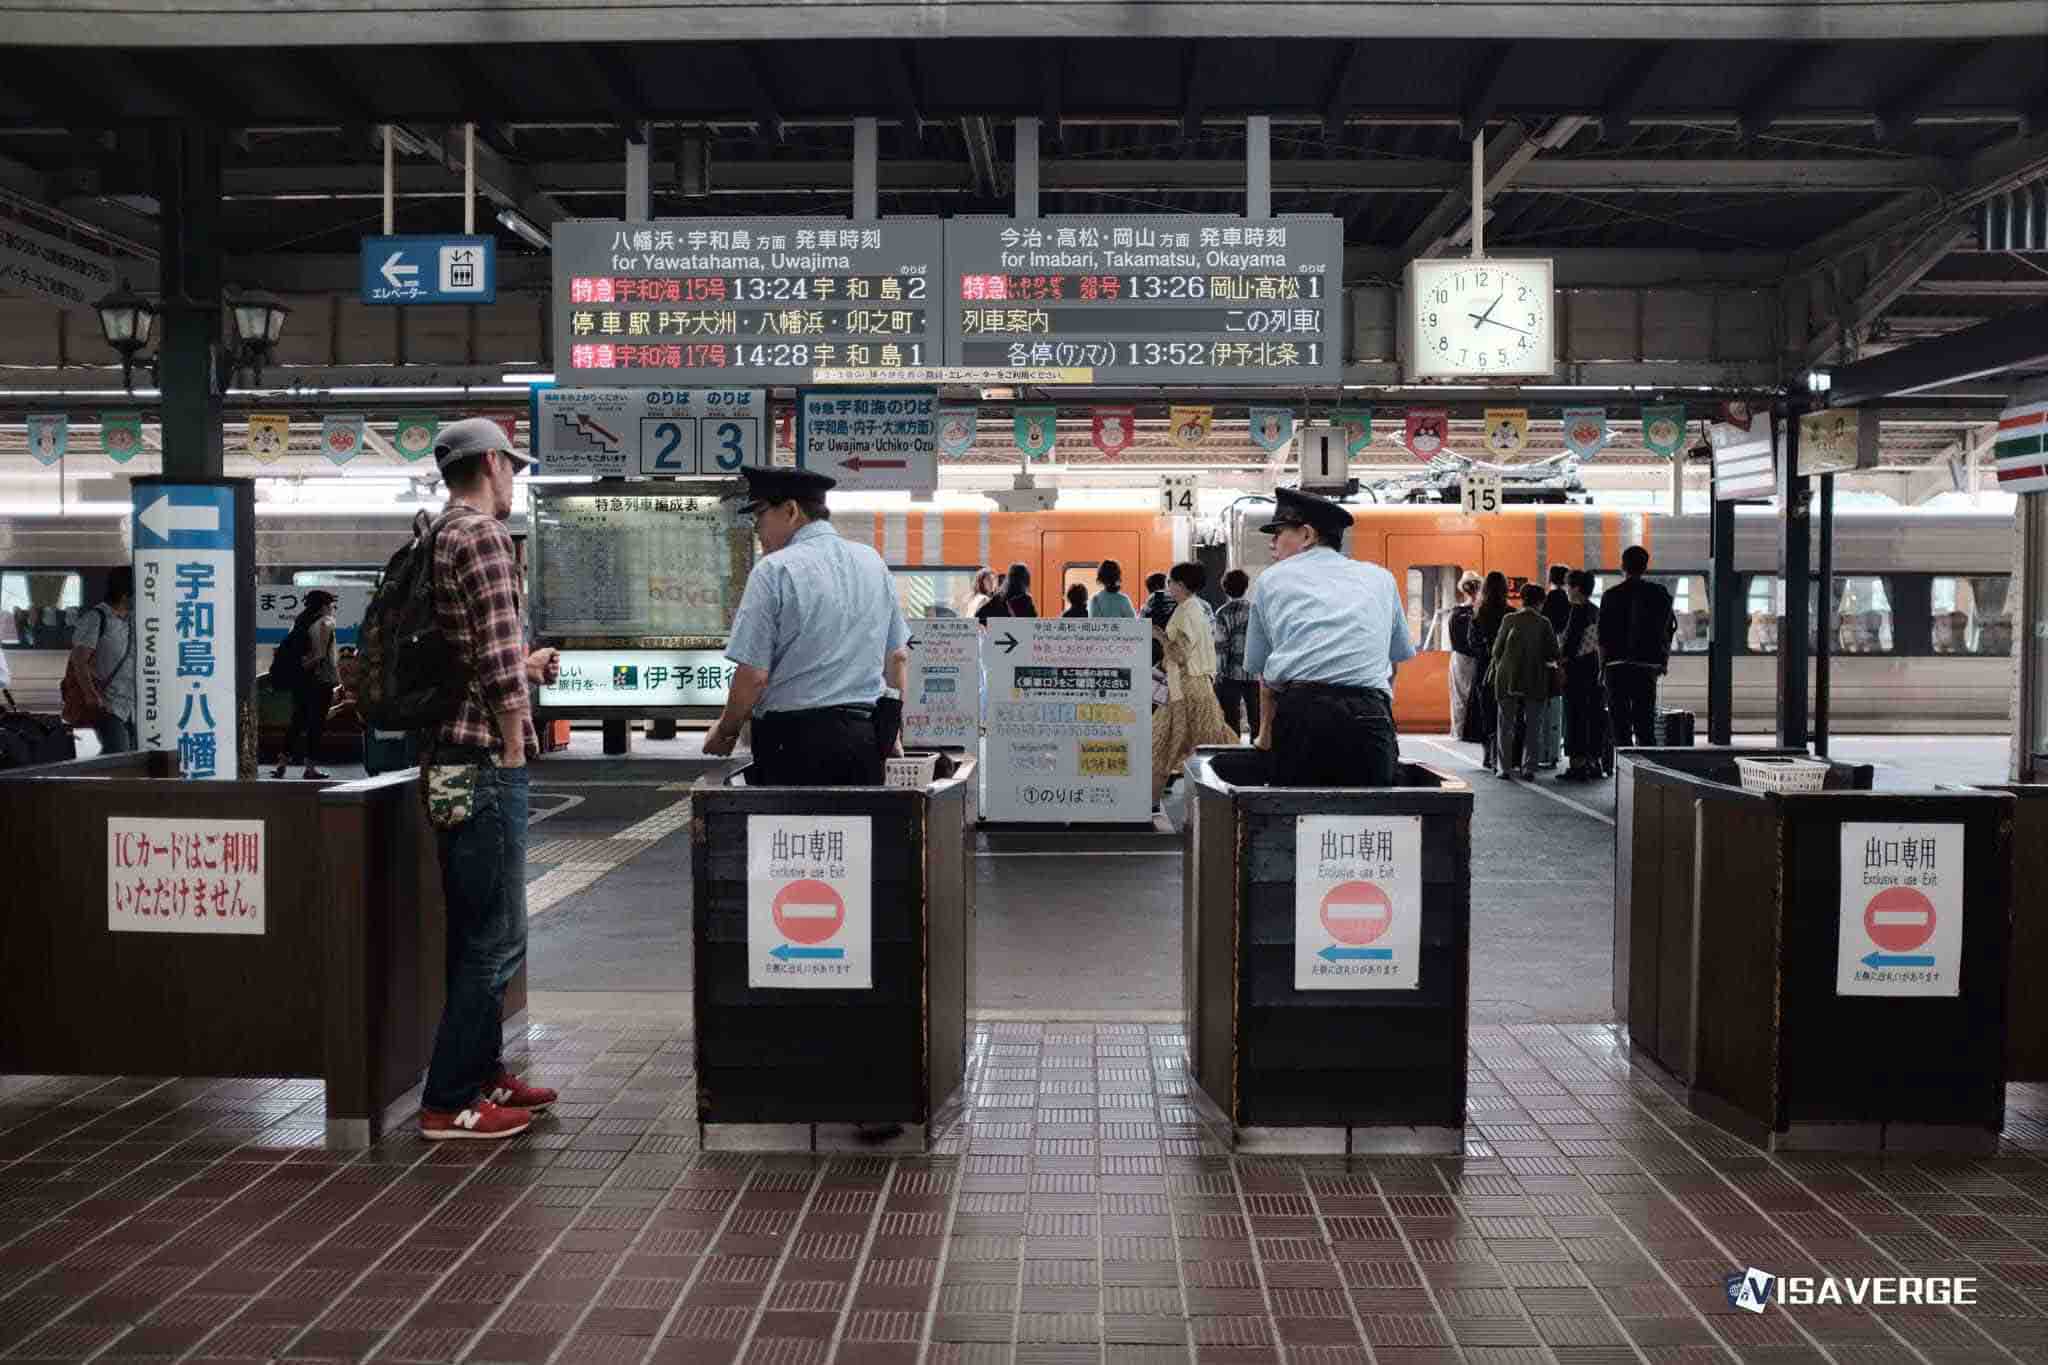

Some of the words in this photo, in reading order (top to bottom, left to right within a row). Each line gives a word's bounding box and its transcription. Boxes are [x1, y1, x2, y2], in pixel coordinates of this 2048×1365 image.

[612, 230, 751, 251] 八幡浜・宇和島
[756, 235, 786, 249] 方面
[796, 229, 881, 250] 発車時刻
[1000, 227, 1155, 248] 今治・高松・岡山
[1160, 232, 1190, 247] 方面
[1199, 227, 1287, 248] 発車時刻
[612, 253, 636, 270] for
[643, 253, 764, 271] Yawatahama,
[771, 253, 850, 271] Uwajima
[901, 264, 928, 275] のりば
[1001, 252, 1026, 268] for
[1029, 252, 1099, 270] Imabari,
[1103, 252, 1199, 269] Takamatsu,
[1206, 252, 1286, 271] Okayama
[1299, 263, 1325, 273] のりば
[961, 274, 1007, 299] 特急
[1129, 277, 1205, 299] 13:26
[1210, 277, 1301, 300] 岡山・高松
[1308, 277, 1321, 299] 1
[1455, 276, 1465, 291] 11
[1476, 272, 1488, 288] 12
[372, 288, 428, 299] エレベーター
[572, 278, 615, 302] 特急
[734, 278, 808, 300] 13:24
[907, 278, 926, 300] 2
[1436, 289, 1448, 304] 10
[1517, 287, 1527, 301] 2
[962, 310, 1049, 333] 列車案内
[1429, 313, 1437, 327] 9
[1527, 313, 1536, 327] 3
[1439, 336, 1448, 351] 8
[1517, 336, 1527, 350] 4
[572, 344, 615, 368] 特急
[734, 344, 808, 366] 14:28
[910, 344, 922, 366] 1
[1128, 344, 1204, 365] 13:52
[1210, 342, 1299, 366] 伊予北条
[1308, 344, 1320, 365] 1
[1460, 349, 1468, 363] 7
[1479, 352, 1487, 367] 6
[1498, 349, 1507, 363] 5
[646, 391, 690, 405] のりば
[707, 391, 751, 405] のりば
[654, 422, 682, 468] 2
[716, 422, 743, 470] 3
[808, 439, 825, 452] For
[595, 499, 699, 512] 特急列車編成表
[1164, 490, 1194, 510] 14
[1467, 489, 1496, 511] 15
[143, 562, 160, 602] For
[175, 561, 217, 783] 宇和島・八幡
[112, 832, 259, 874] ICカードはご利用
[772, 829, 843, 862] 出口専用
[1320, 829, 1393, 862] 出口専用
[1865, 836, 1936, 869] 出口専用
[115, 877, 257, 919] いただけません。
